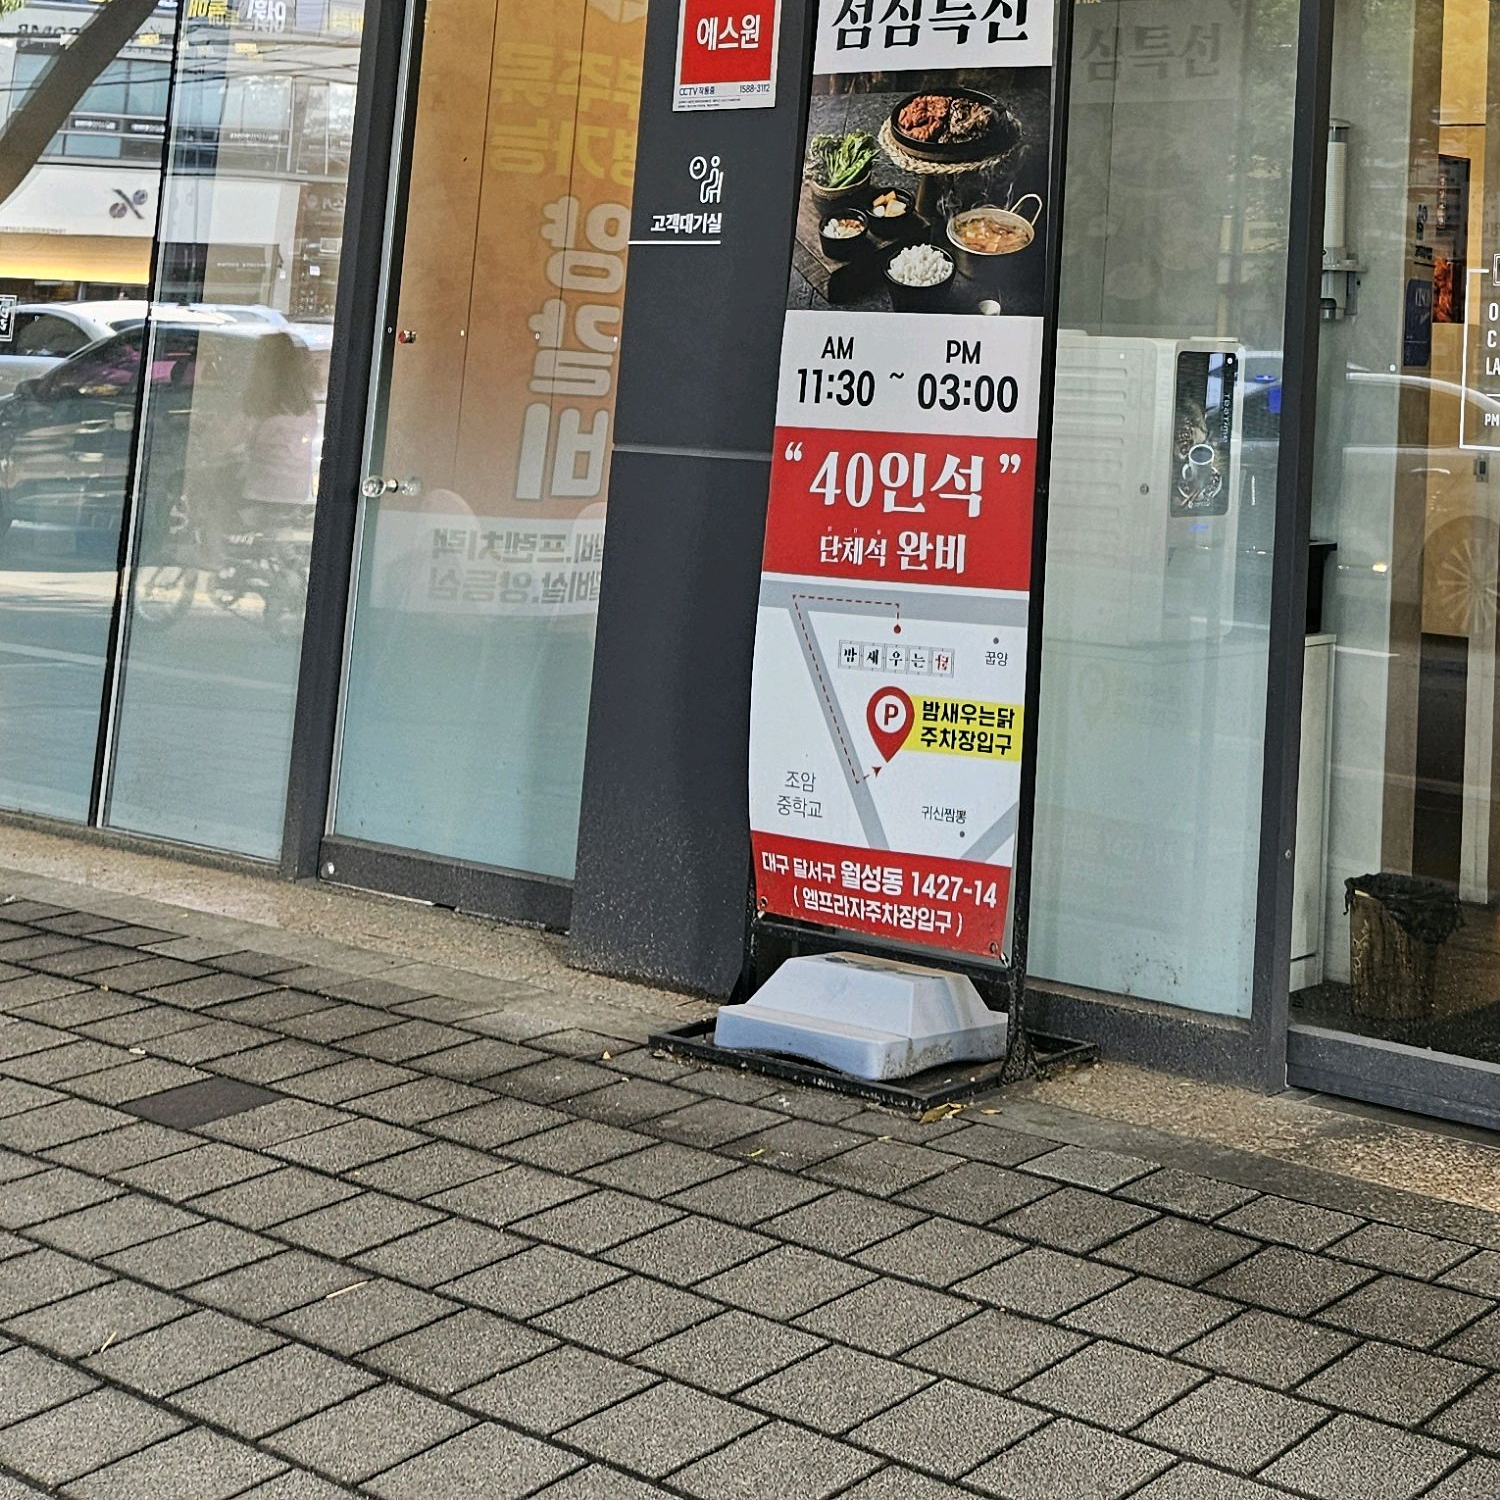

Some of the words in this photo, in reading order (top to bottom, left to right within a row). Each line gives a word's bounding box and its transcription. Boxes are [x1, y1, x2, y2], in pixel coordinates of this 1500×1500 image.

[696, 14, 761, 51] 에스원
[650, 212, 722, 235] 고객대기실
[821, 336, 855, 360] AM
[946, 340, 981, 364] PM
[798, 368, 875, 407] 11:30
[917, 373, 1019, 413] 03:00
[820, 535, 888, 568] 단체석
[896, 531, 967, 574] 완비
[883, 703, 899, 726] P
[921, 700, 1015, 730] 밤새우는닭
[920, 726, 1012, 756] 주차장입구
[784, 770, 817, 793] 조암
[776, 795, 824, 819] 중학교
[921, 806, 967, 824] 귀신짬뽕
[761, 851, 790, 875] 대구
[793, 857, 836, 884] 달서구
[840, 860, 904, 896] 월성동
[911, 871, 997, 908] 1427-14
